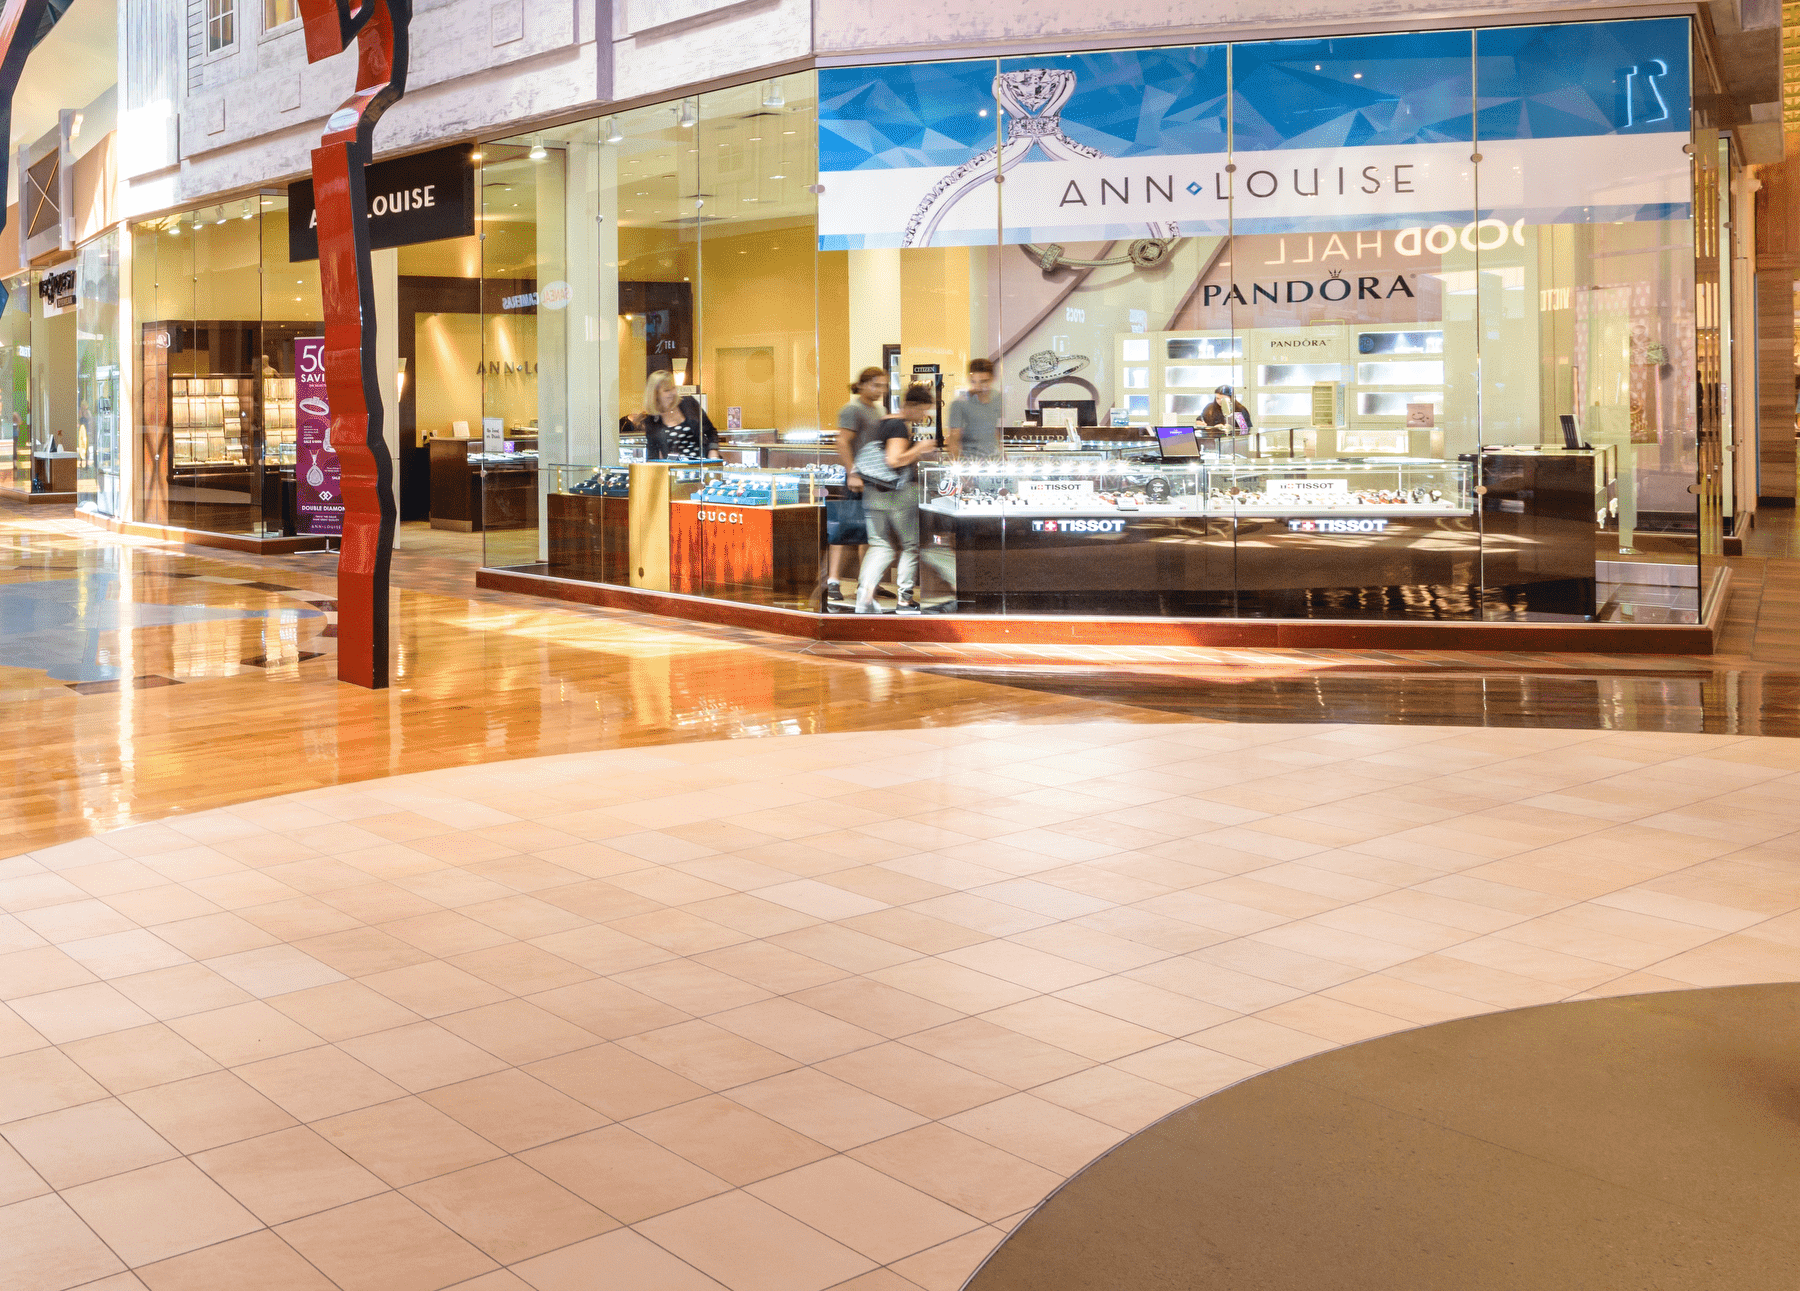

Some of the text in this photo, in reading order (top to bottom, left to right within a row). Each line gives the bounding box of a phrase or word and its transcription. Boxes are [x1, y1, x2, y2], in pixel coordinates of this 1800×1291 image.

[1058, 163, 1415, 208] ANN LOUISE
[366, 184, 436, 220] OUISE
[1203, 272, 1415, 307] PANDORA
[1270, 338, 1327, 348] PANDORA
[301, 373, 325, 383] SAVI
[1044, 483, 1082, 491] TISSOT
[1296, 482, 1335, 490] TISSOT
[697, 510, 744, 524] GUCCI
[1057, 519, 1126, 532] TISSOT
[1317, 519, 1388, 532] TISSOT
